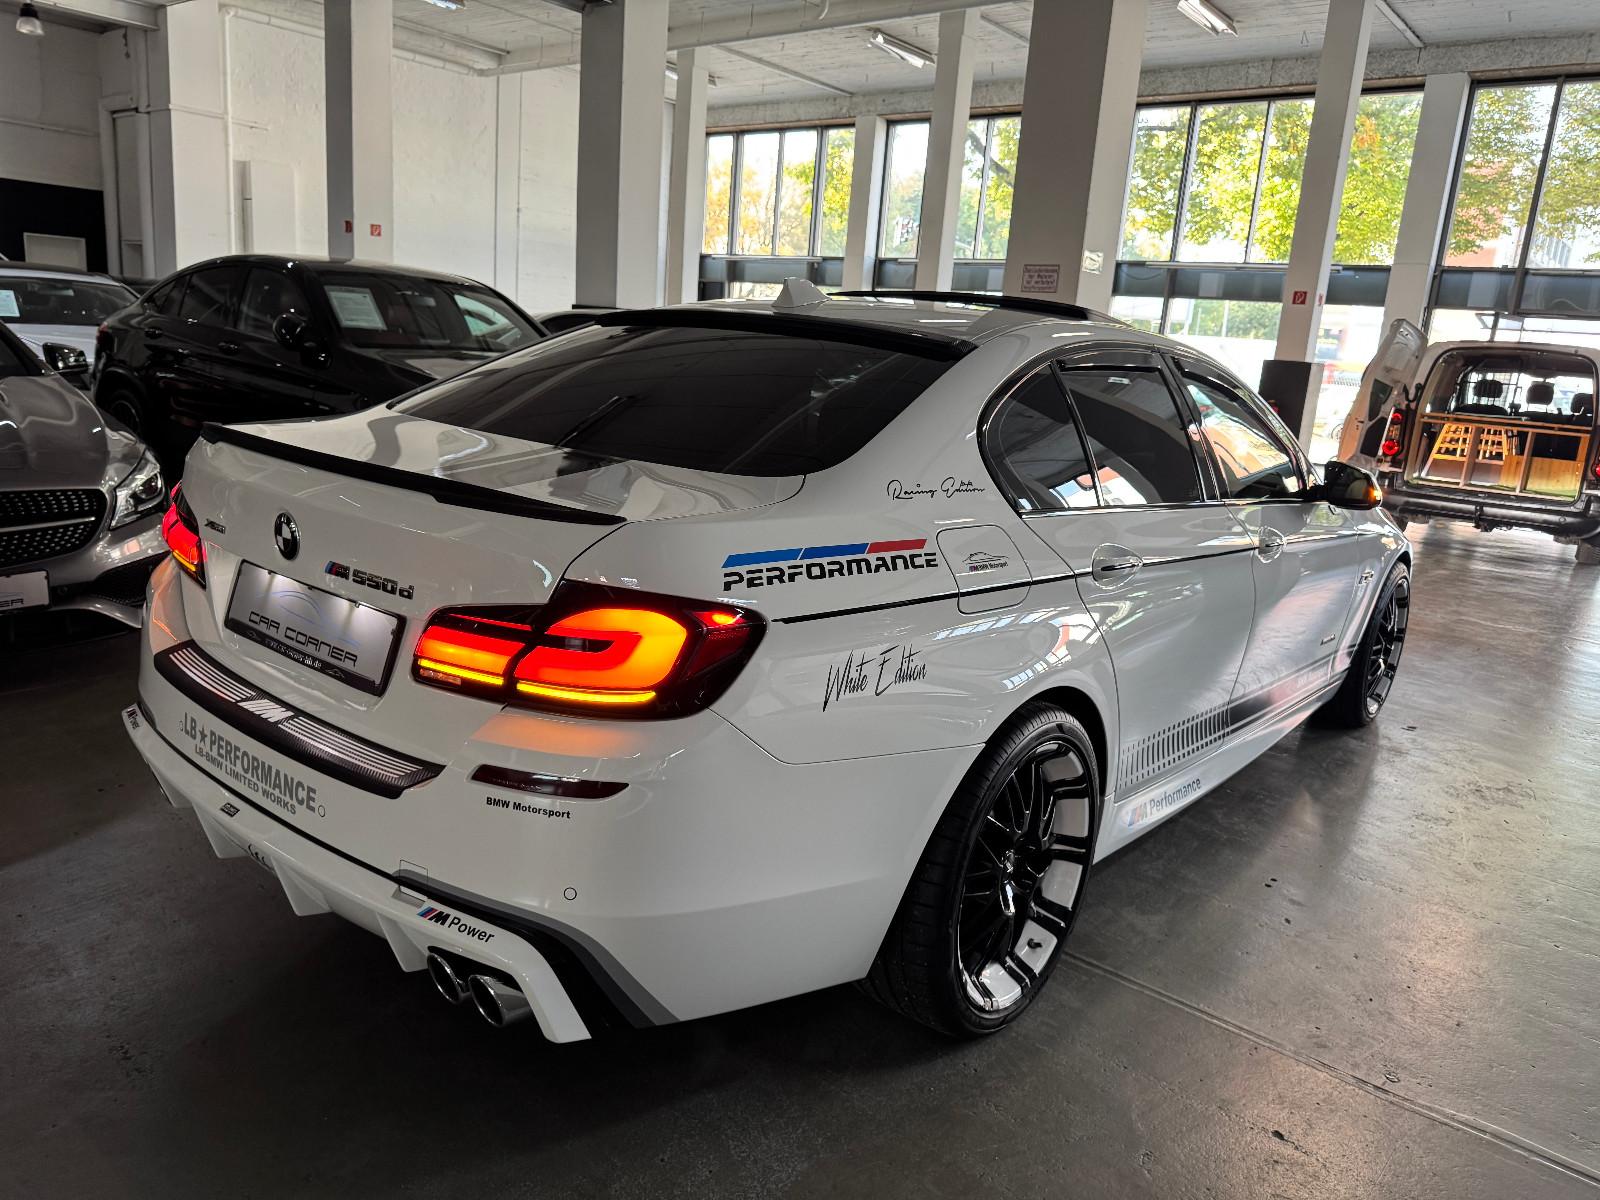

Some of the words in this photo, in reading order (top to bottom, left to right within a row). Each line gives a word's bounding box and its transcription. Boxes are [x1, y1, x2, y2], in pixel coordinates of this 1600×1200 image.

[722, 552, 938, 591] PERFORMANCE
[249, 611, 281, 634] CAR
[284, 626, 358, 668] CORNER
[822, 650, 876, 712] White
[873, 644, 927, 696] Edition
[184, 712, 197, 740] LB
[209, 730, 317, 812] PERFORMANCE
[195, 743, 223, 772] LB-BMW
[225, 766, 260, 794] LIMITED
[262, 787, 297, 816] WORKS
[486, 796, 511, 809] BMW
[513, 801, 571, 819] Motorsport
[1149, 778, 1202, 816] Performance
[449, 916, 495, 943] Power
